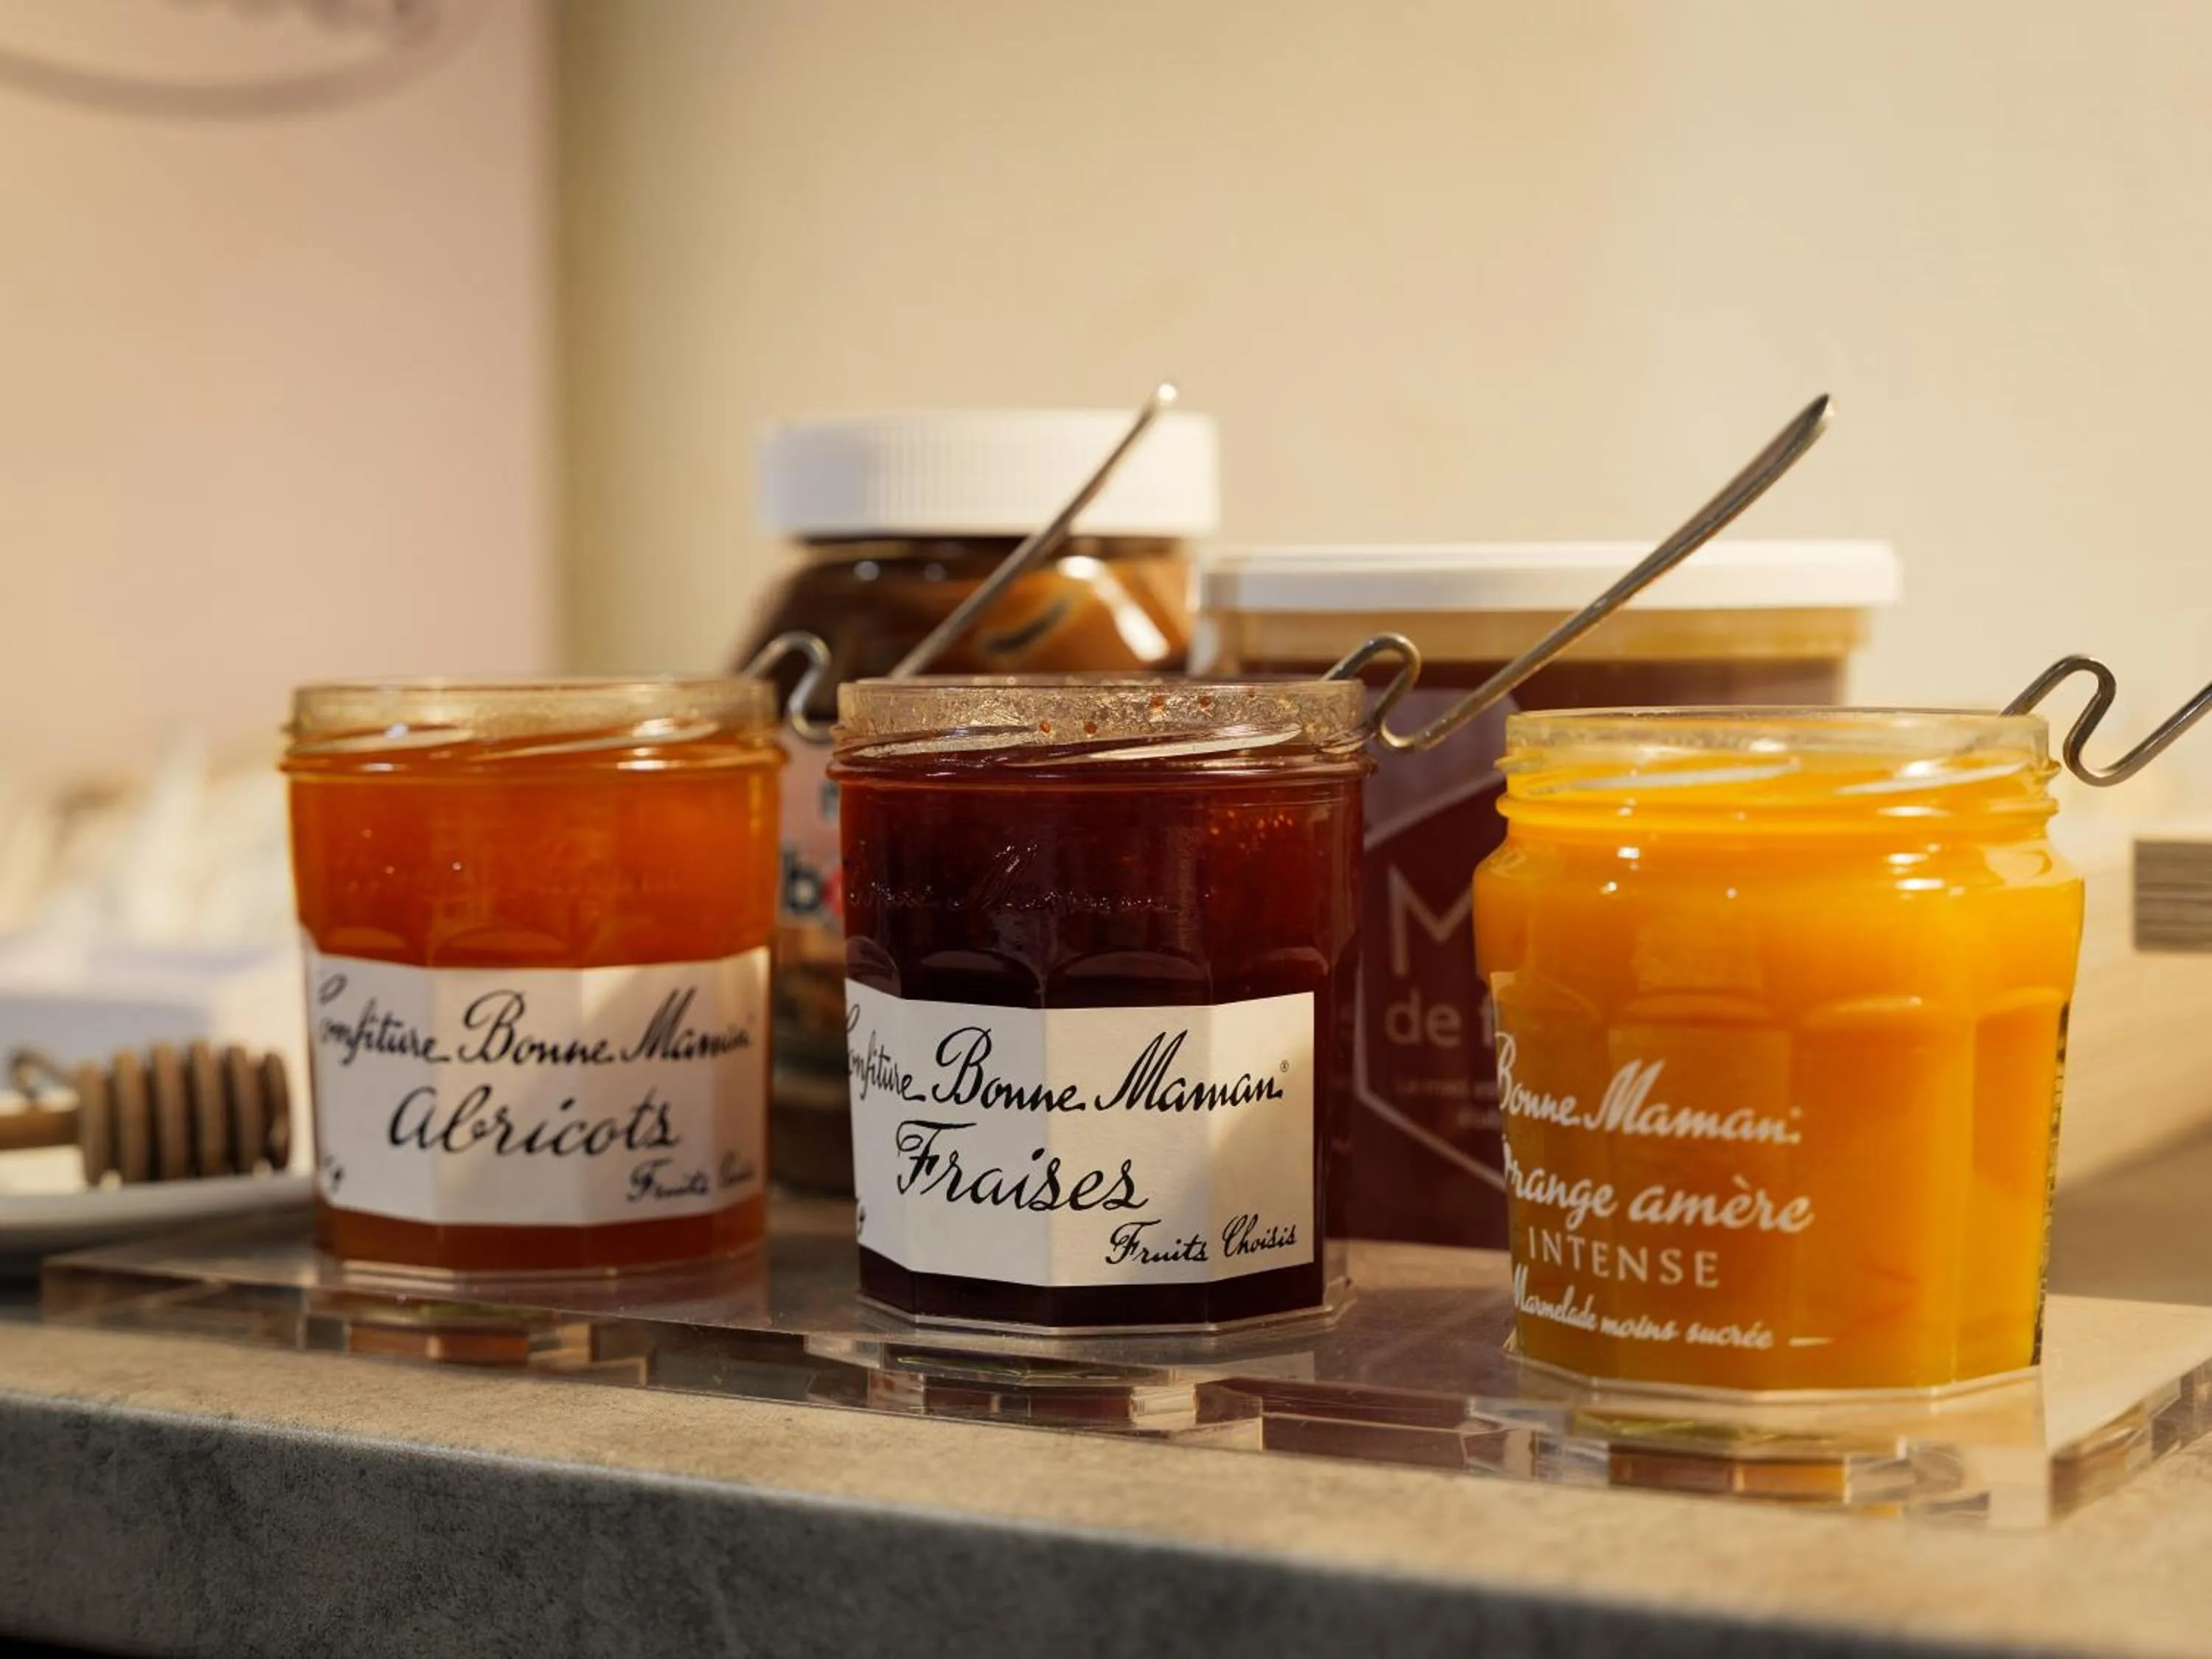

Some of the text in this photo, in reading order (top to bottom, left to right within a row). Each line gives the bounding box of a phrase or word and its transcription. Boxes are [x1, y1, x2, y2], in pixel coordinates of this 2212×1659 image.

[459, 990, 614, 1065] Bonne
[1385, 987, 1463, 1049] de
[932, 1026, 1085, 1111] Bonne
[388, 1085, 679, 1156] Abricots
[896, 1121, 1149, 1211] Fraises
[1628, 1175, 1815, 1234] amère
[1105, 1214, 1297, 1265] Fruits Choisis
[1528, 1225, 1719, 1289] INTENSE
[1600, 1315, 1680, 1342] moins
[1685, 1321, 1774, 1350] sucrée
